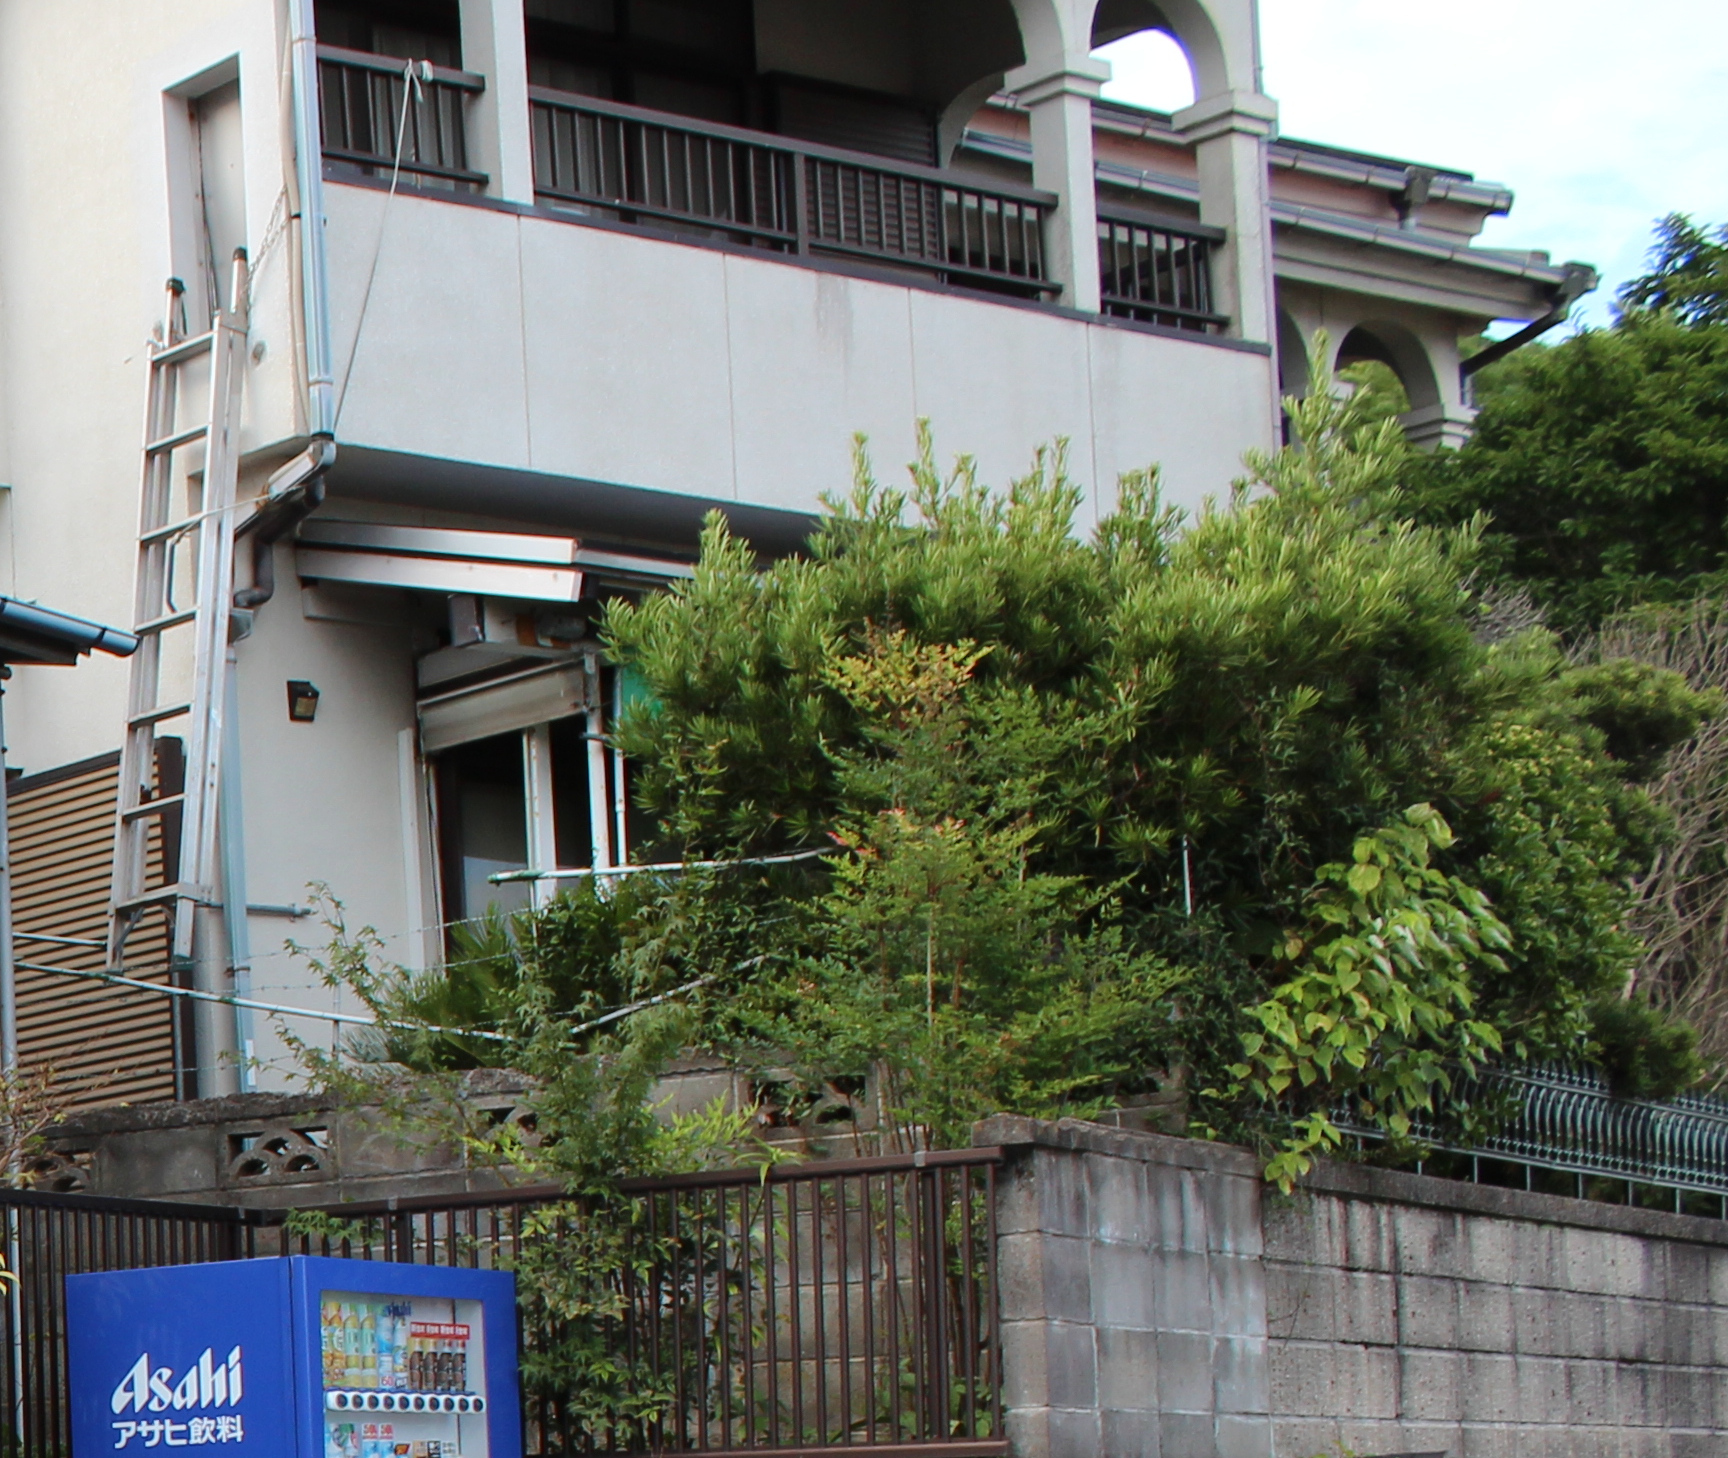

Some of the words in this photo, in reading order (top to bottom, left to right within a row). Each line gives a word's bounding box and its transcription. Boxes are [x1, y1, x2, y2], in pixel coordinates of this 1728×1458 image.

[111, 1344, 243, 1415] Asahi
[111, 1414, 244, 1450] アサヒ飲料
